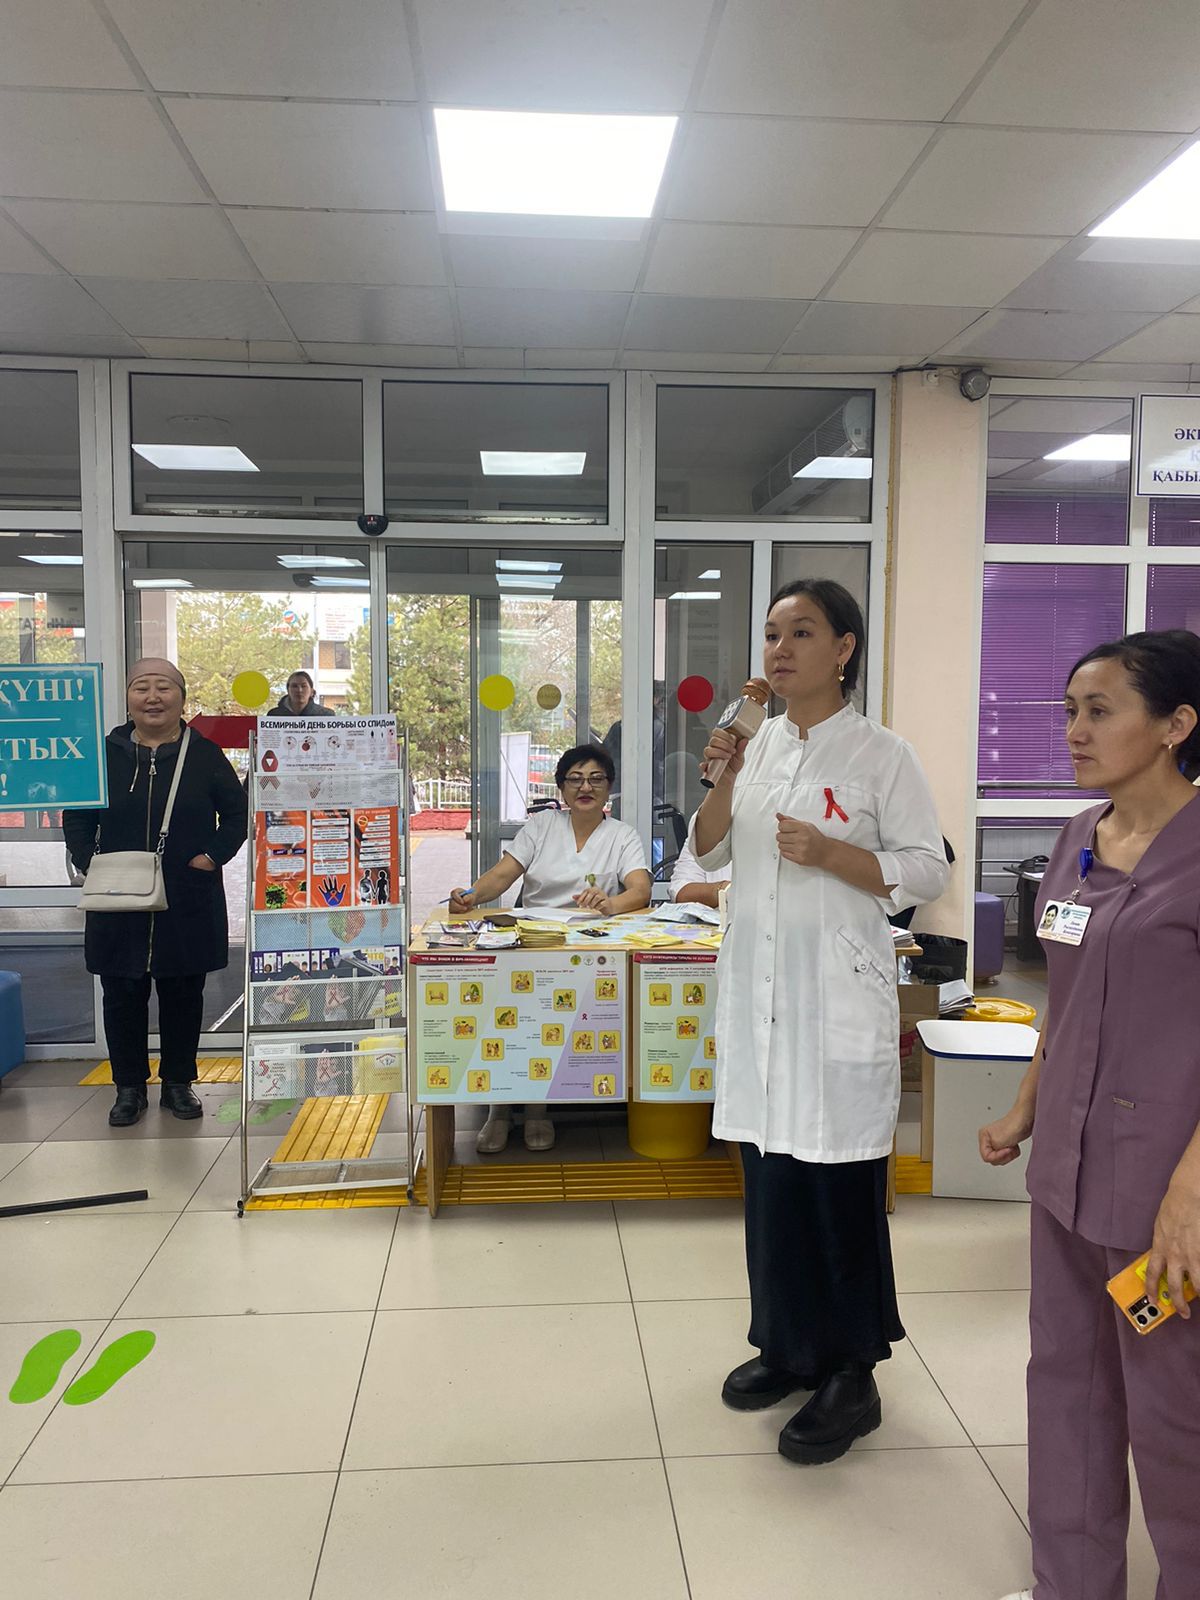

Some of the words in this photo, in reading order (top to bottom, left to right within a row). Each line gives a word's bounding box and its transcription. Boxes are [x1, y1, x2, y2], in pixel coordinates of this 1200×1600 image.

[1153, 470, 1200, 483] ҚАБЫ
[260, 719, 306, 729] ВСЕМИРНЫЙ
[307, 720, 326, 730] ДЕНЬ
[327, 720, 356, 729] БОРЬБЫ
[357, 720, 366, 728] СО
[368, 719, 395, 728] СПИДом
[0, 736, 85, 761] ТЫХ
